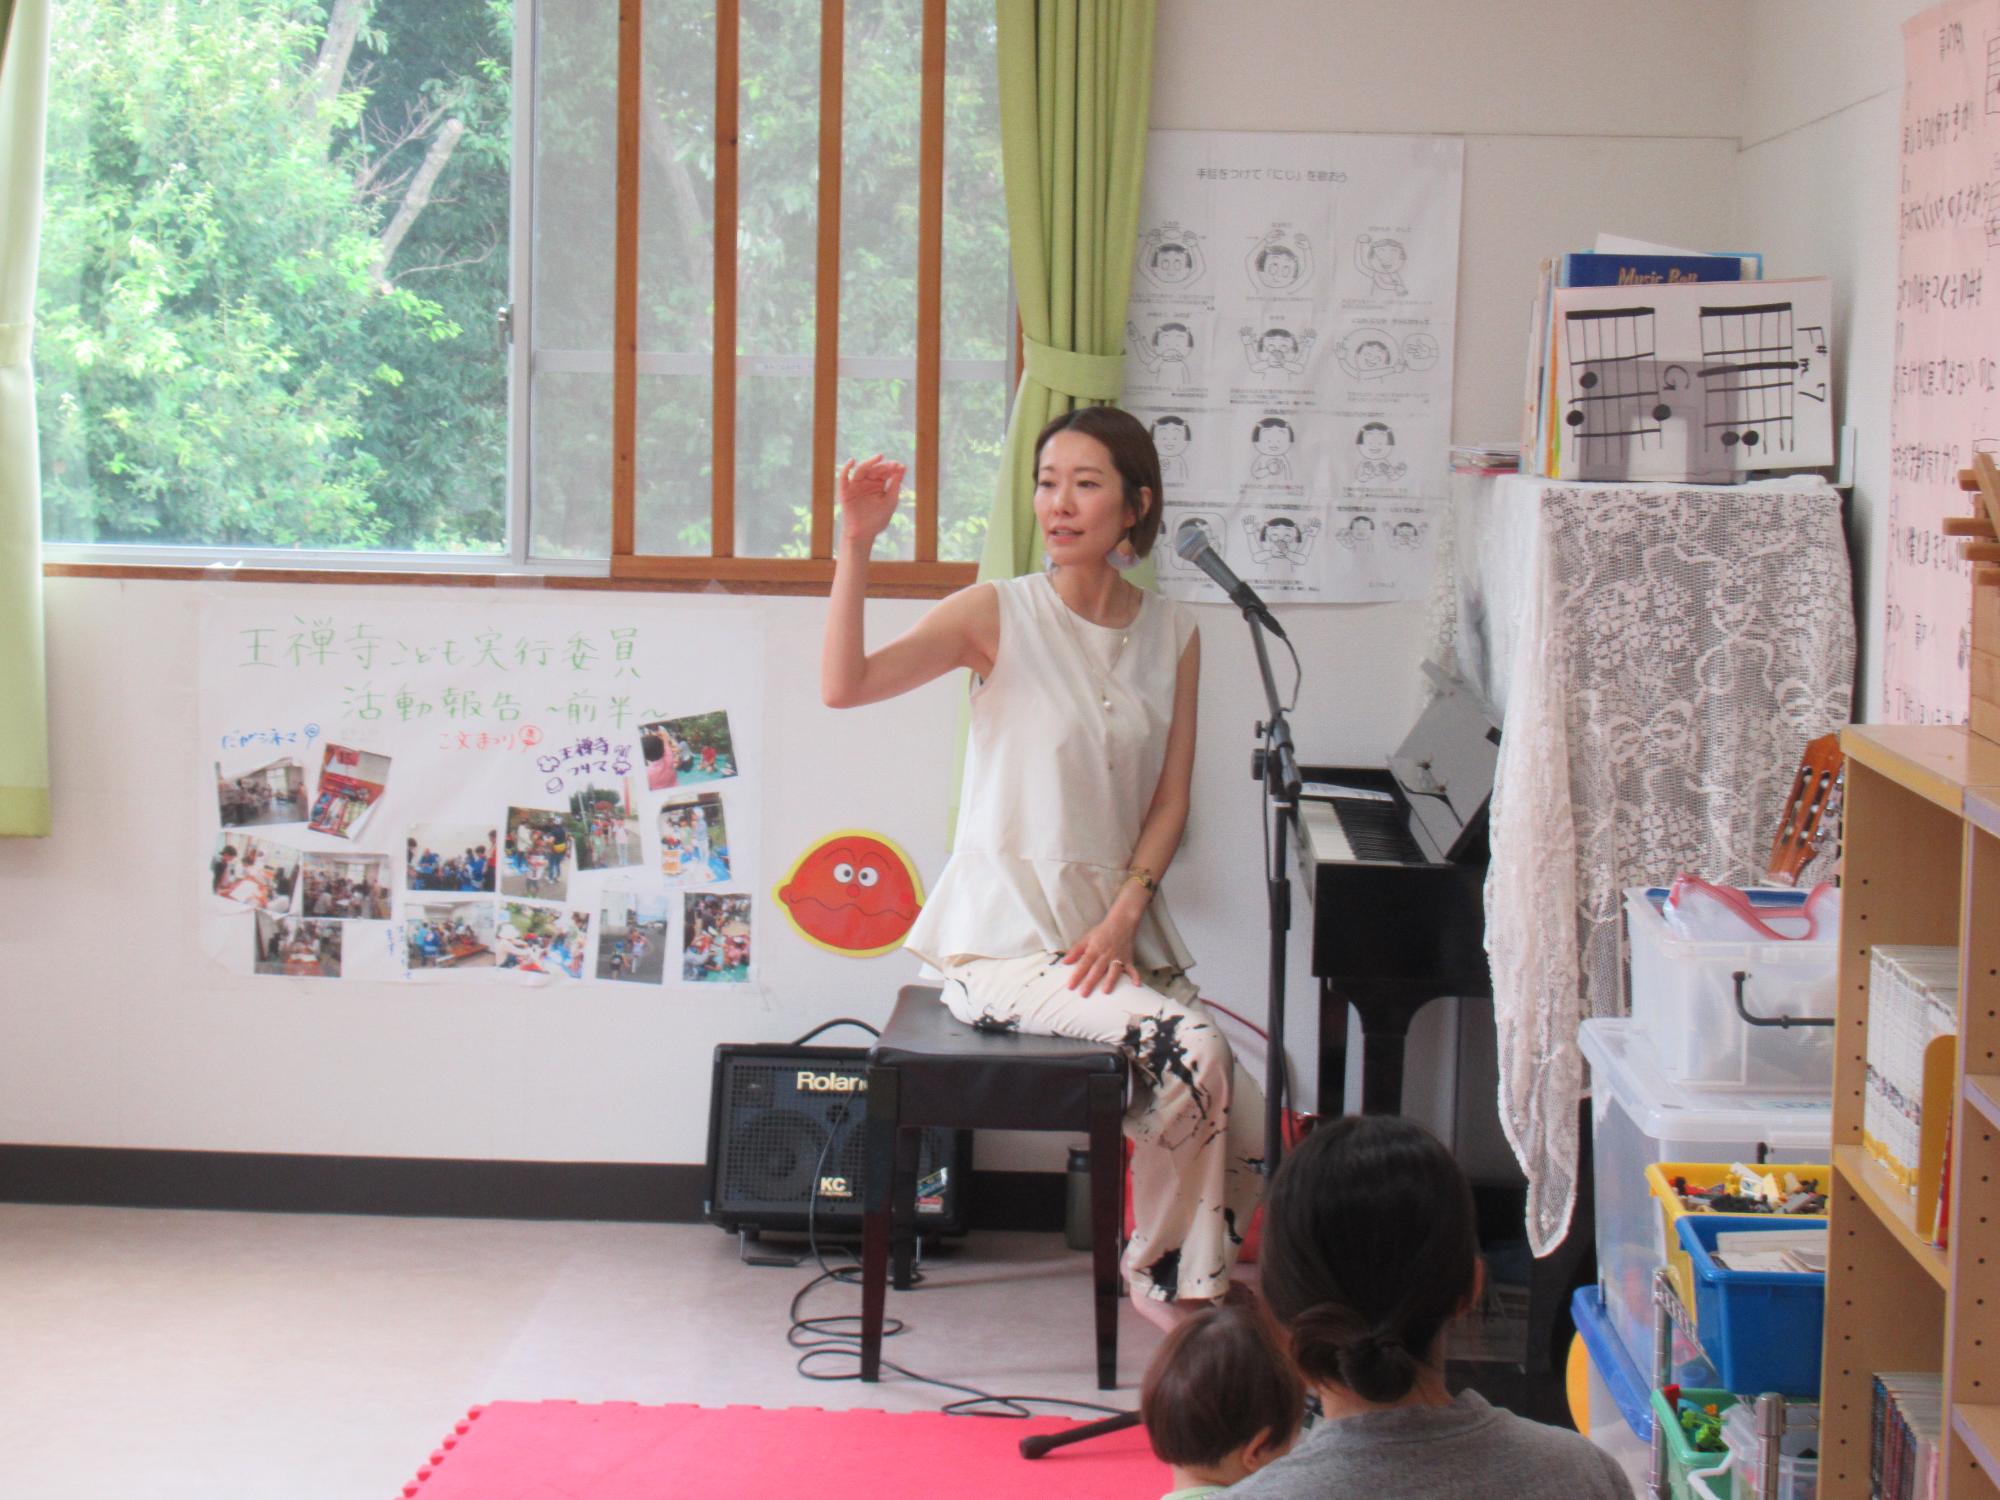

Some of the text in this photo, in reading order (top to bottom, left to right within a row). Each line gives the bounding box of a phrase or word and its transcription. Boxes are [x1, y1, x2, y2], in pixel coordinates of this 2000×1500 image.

[1618, 266, 1663, 285] Music
[338, 684, 522, 723] 活動報告
[796, 1071, 869, 1091] Rolan
[820, 1176, 848, 1192] KC
